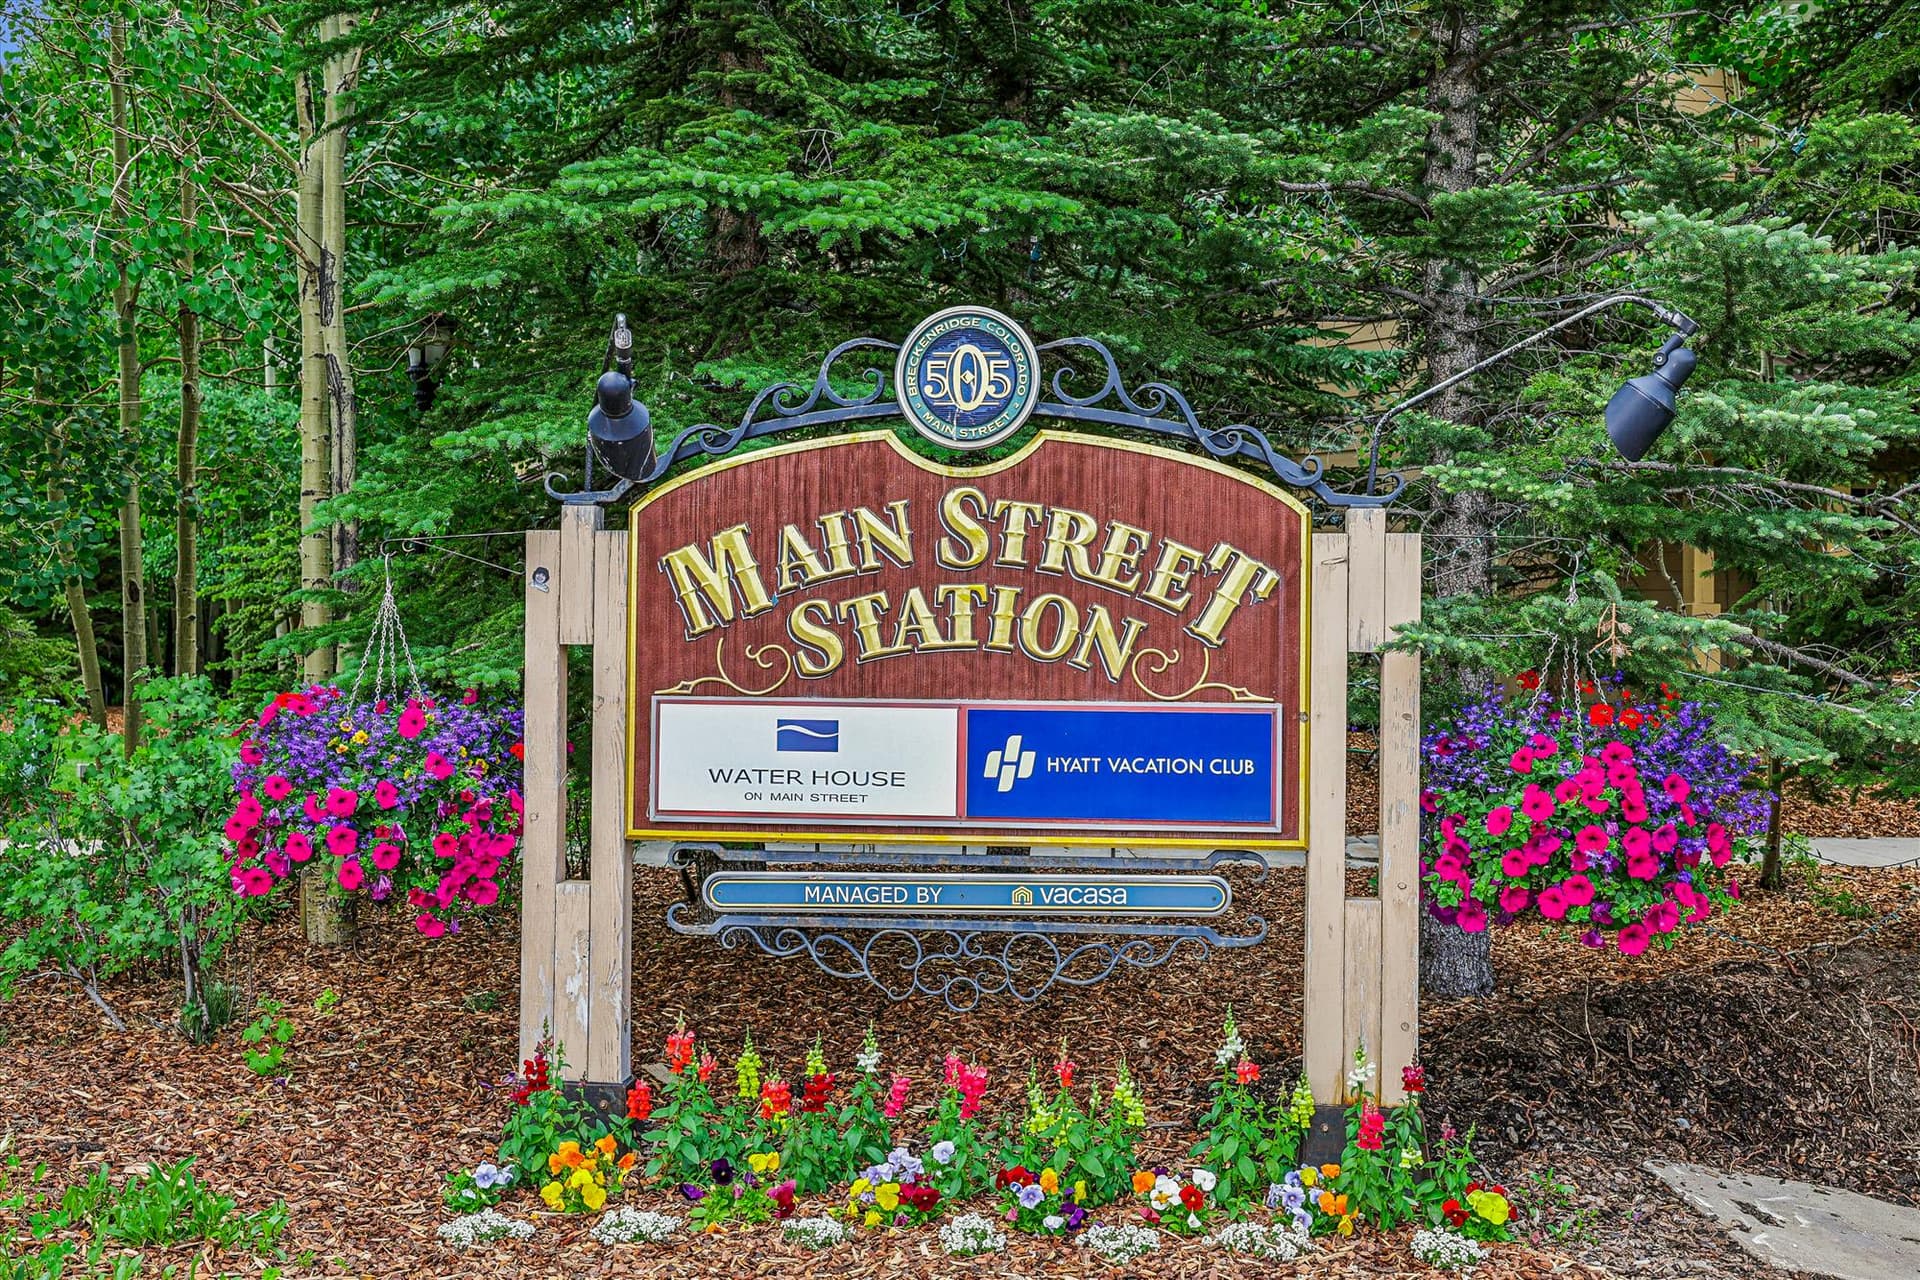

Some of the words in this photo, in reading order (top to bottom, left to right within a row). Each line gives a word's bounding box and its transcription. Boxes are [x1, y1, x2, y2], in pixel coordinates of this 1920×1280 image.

[906, 317, 981, 397] BRECKENRIDGE
[986, 321, 1027, 396] COLORADO
[924, 344, 1012, 411] 505
[922, 411, 956, 436] MAIN
[959, 413, 1011, 438] STREET
[659, 499, 914, 642] MAIN
[936, 486, 1284, 648] STREET
[786, 583, 1148, 684] STATION
[708, 768, 804, 785] WATER
[812, 770, 906, 787] HOUSE
[1047, 757, 1101, 773] HYATT
[1108, 758, 1203, 774] VACATION
[1209, 758, 1255, 775] CLUB
[744, 791, 763, 801] ON
[770, 792, 804, 802] MAIN
[810, 793, 868, 804] STREET
[804, 886, 908, 904] MANAGED
[915, 886, 943, 904] BY
[1040, 887, 1127, 905] vacasa
